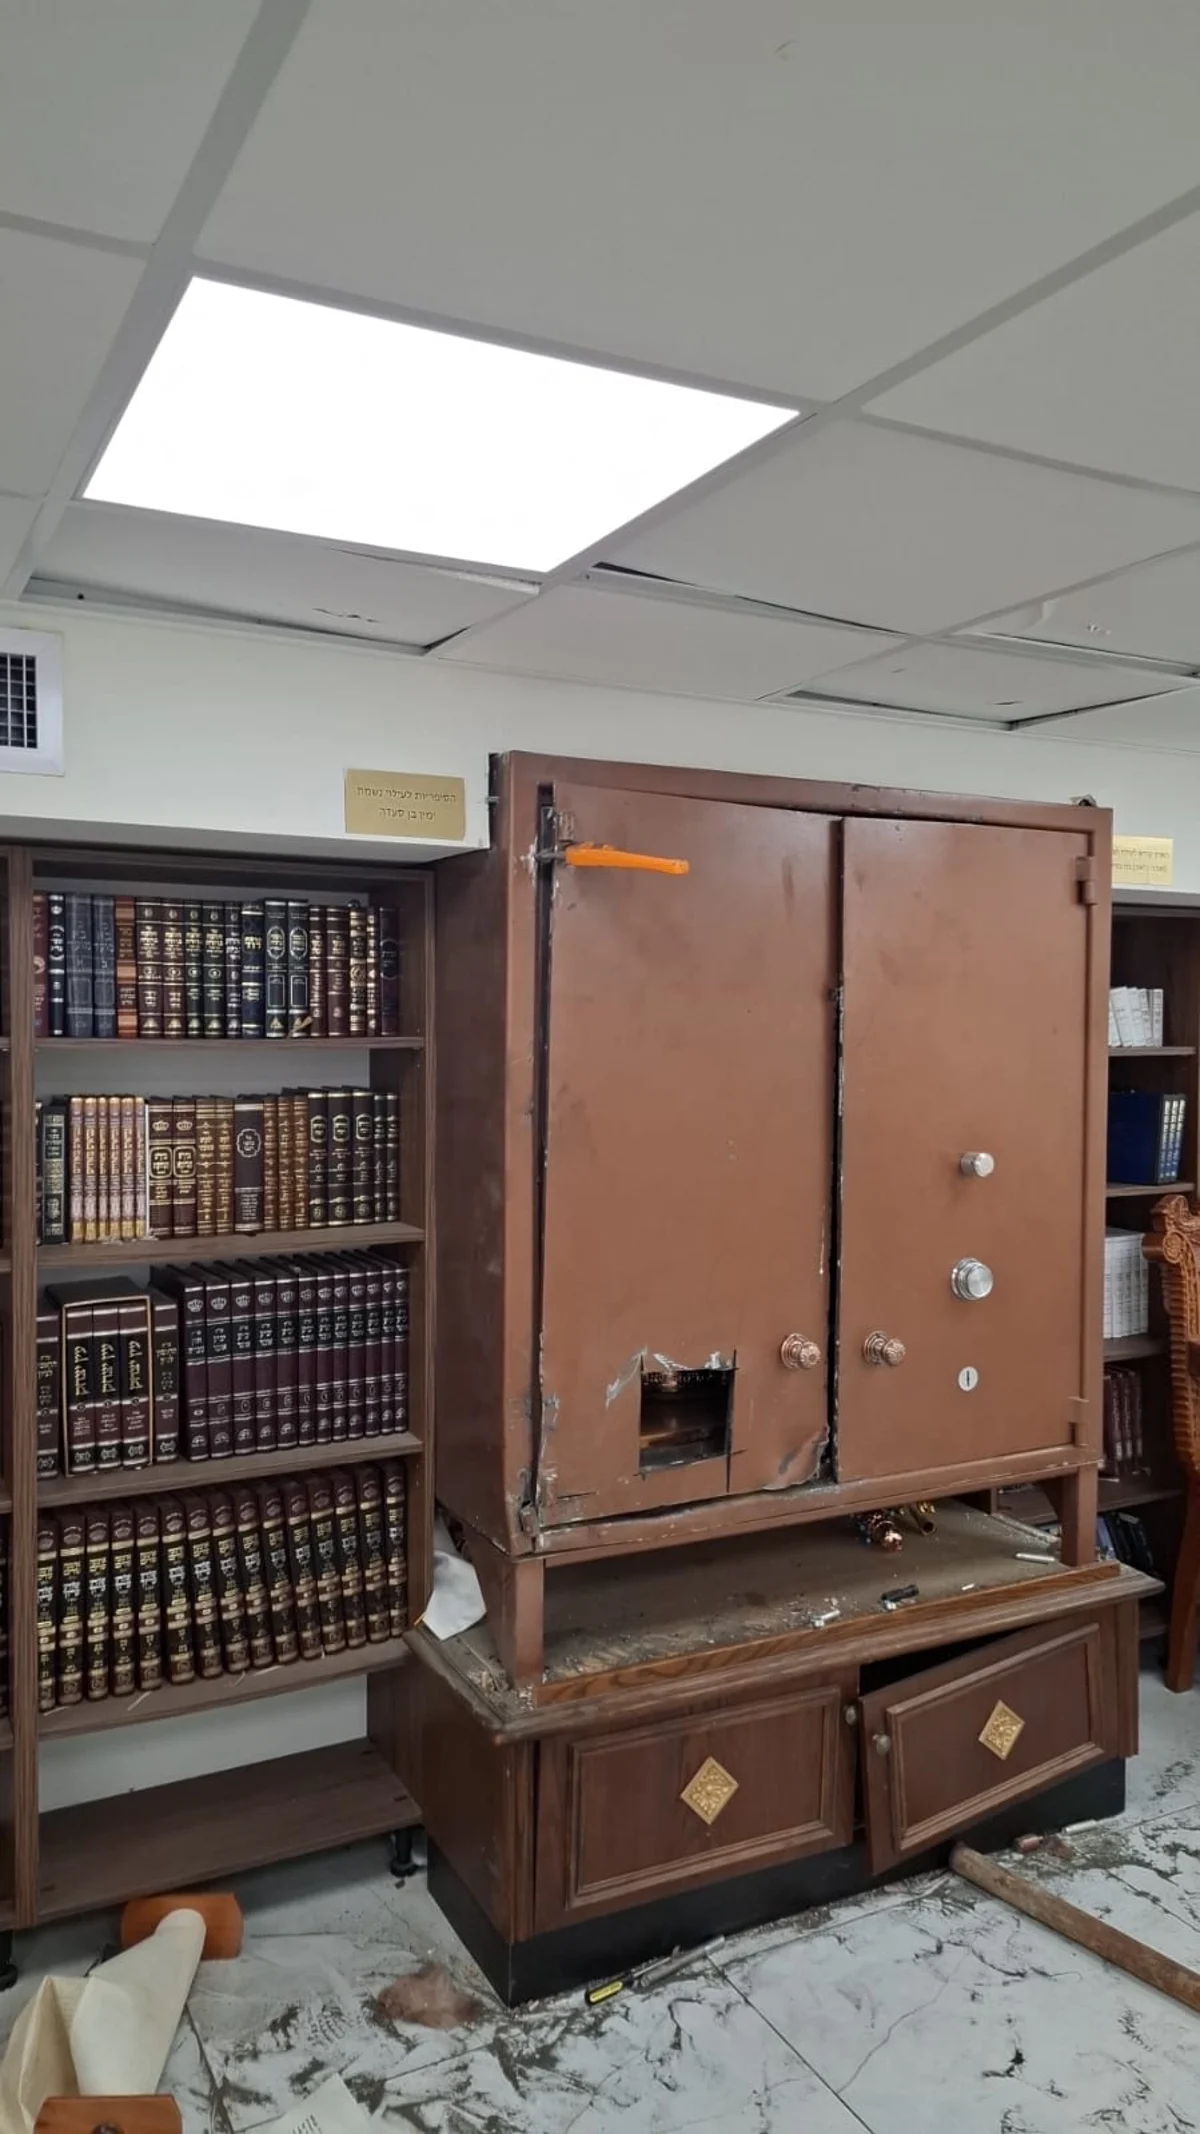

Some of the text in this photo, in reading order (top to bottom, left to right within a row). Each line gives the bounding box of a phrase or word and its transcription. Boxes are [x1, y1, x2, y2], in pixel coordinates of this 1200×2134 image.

[356, 785, 382, 797] נשמת
[385, 787, 412, 799] לעילוי
[407, 810, 417, 821] בן
[74, 1346, 91, 1396] עין יצחק
[100, 1343, 117, 1393] עין יצחק
[128, 1340, 143, 1390] עין יצחק
